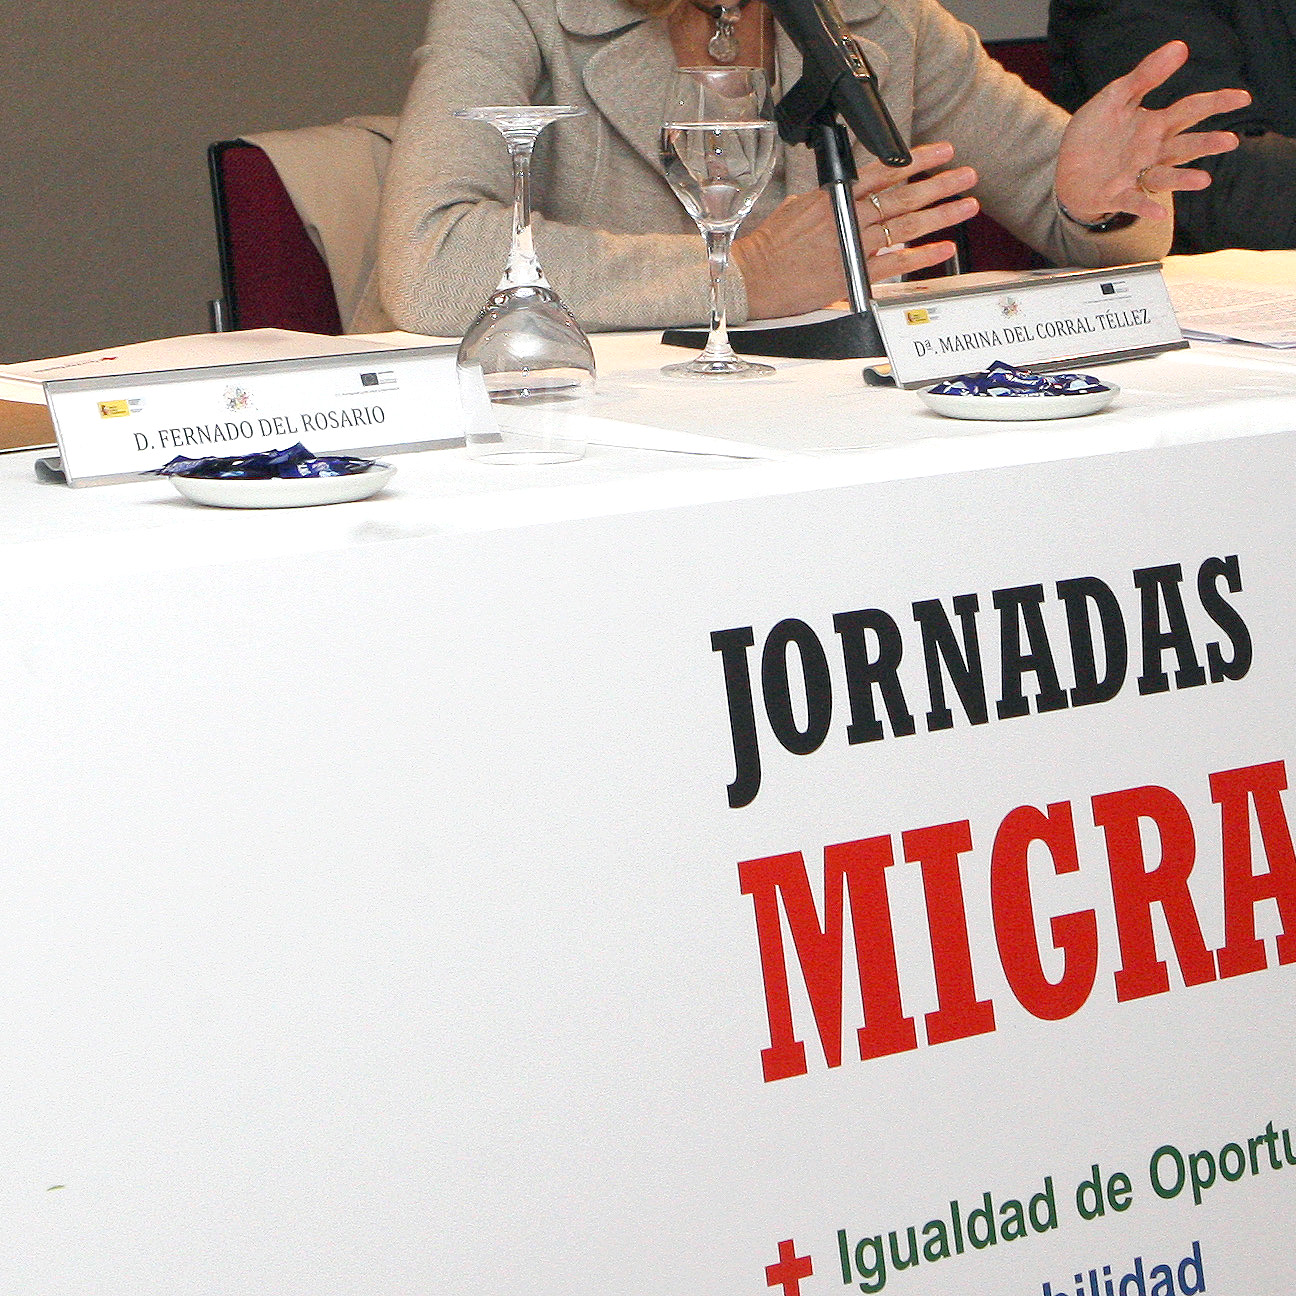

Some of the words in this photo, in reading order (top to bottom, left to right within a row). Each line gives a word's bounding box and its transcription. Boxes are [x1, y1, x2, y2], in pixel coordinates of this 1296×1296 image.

[940, 329, 1001, 353] MARINA
[1003, 325, 1035, 344] DEL
[1035, 316, 1096, 339] CORRAL
[1094, 307, 1152, 333] TÉLLEZ
[133, 431, 154, 452] D.
[158, 420, 254, 450] FERNADO
[258, 416, 299, 437] DEL
[300, 405, 386, 432] ROSARIO
[710, 555, 1253, 809] JORNADAS
[836, 1175, 1059, 1295] Igualdad
[1075, 1163, 1134, 1221] de
